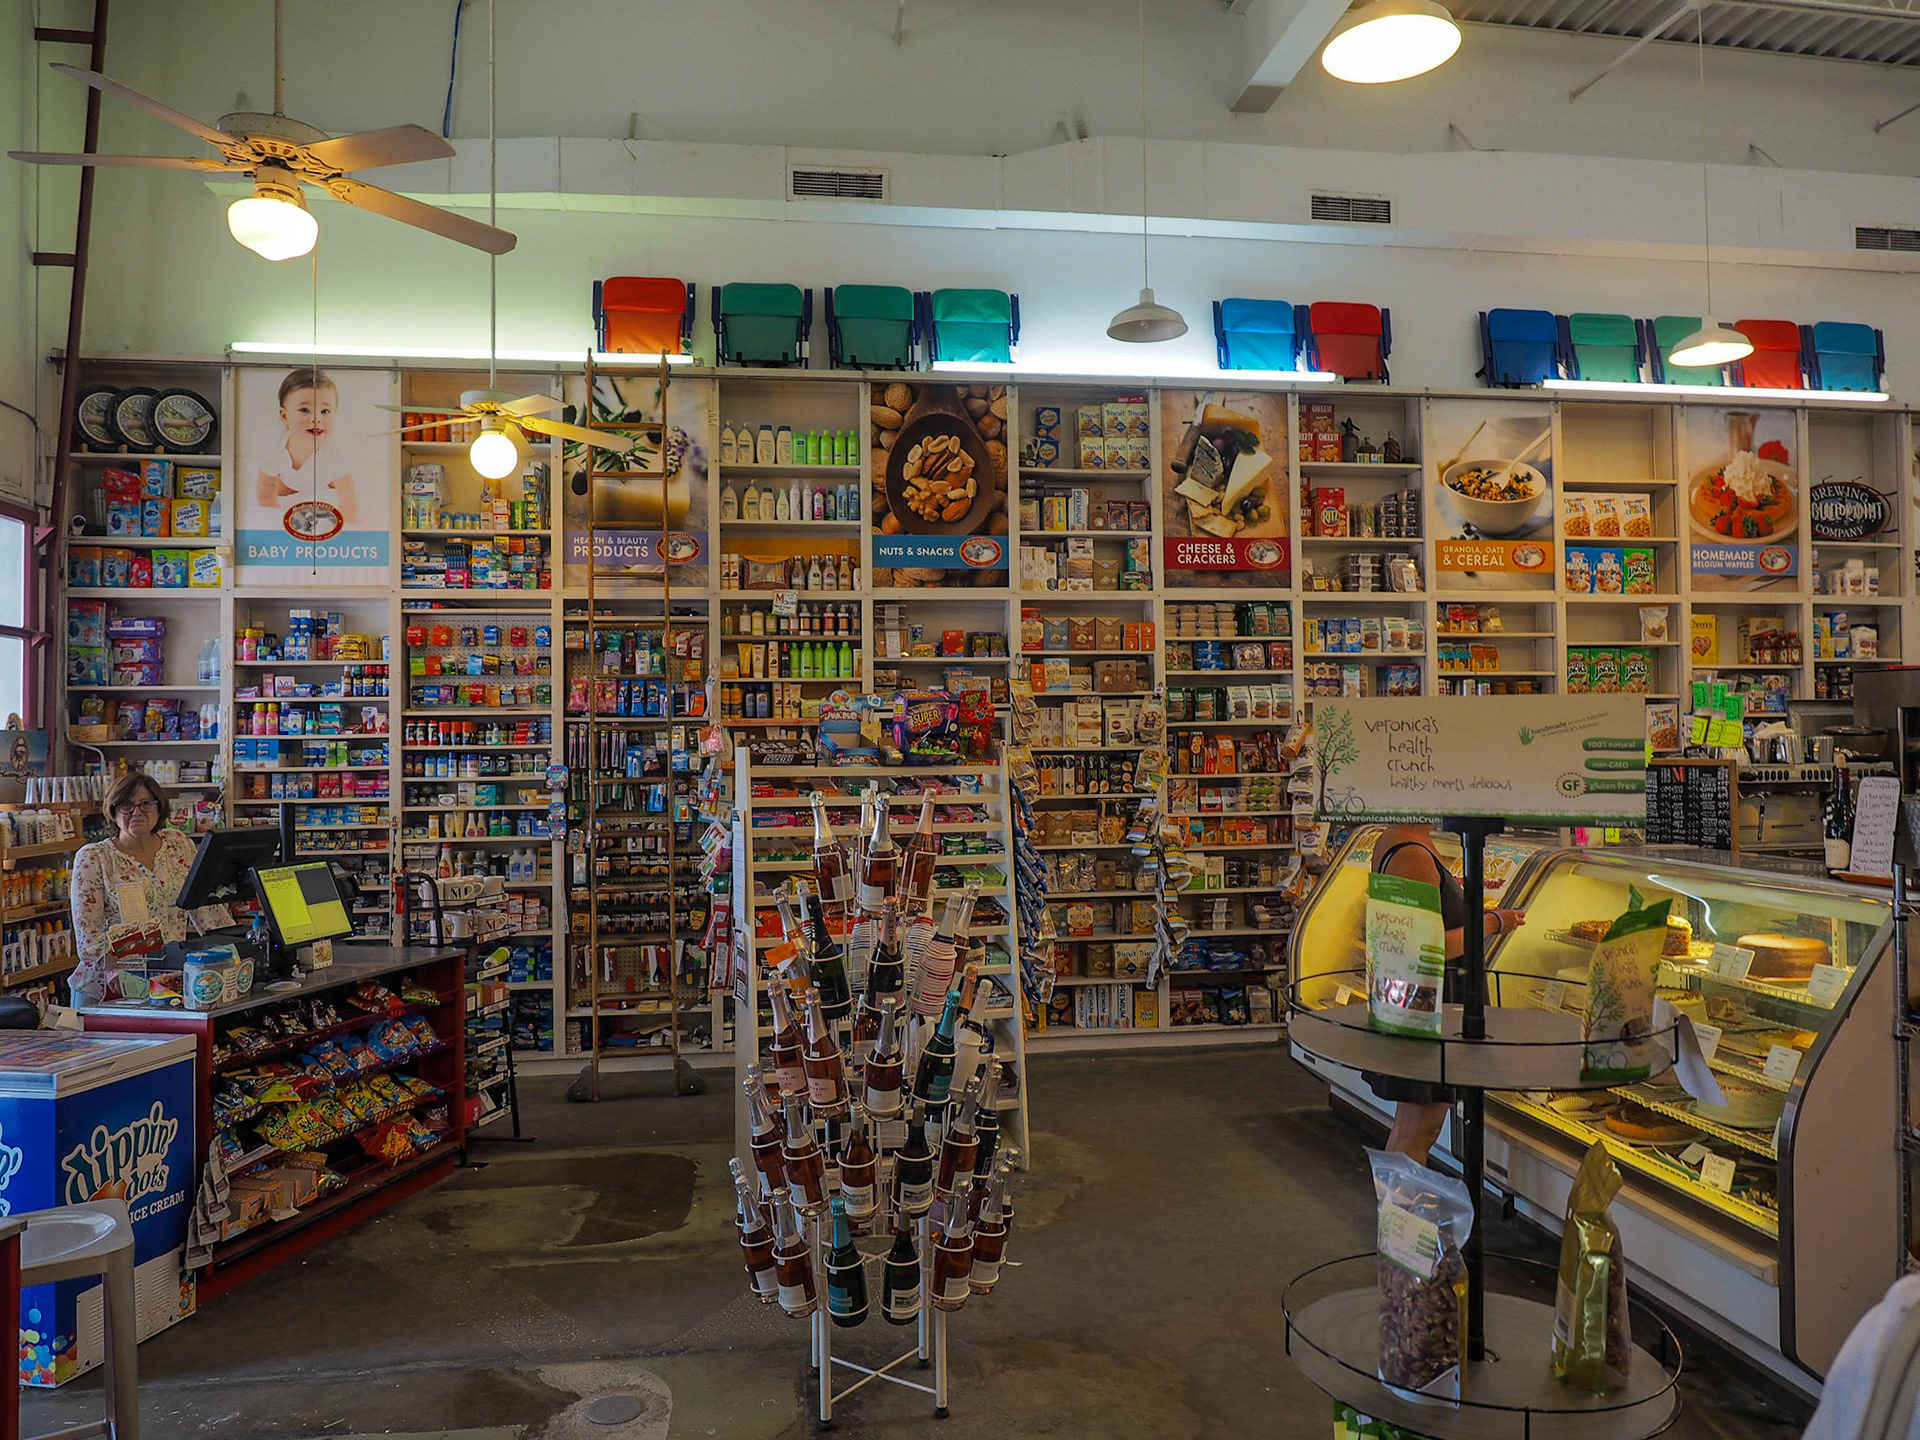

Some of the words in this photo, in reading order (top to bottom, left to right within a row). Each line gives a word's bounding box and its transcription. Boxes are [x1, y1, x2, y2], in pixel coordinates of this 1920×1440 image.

[1105, 409, 1126, 418] Triscuit
[1128, 409, 1148, 418] Triscuit
[1083, 443, 1103, 451] Triscuit
[1811, 485, 1869, 503] BREWING
[1322, 511, 1341, 523] RITZ
[1815, 523, 1863, 538] COMPANY
[574, 536, 605, 545] HEATH
[249, 546, 289, 558] BABY
[295, 546, 378, 558] PRODUCTS
[574, 546, 649, 557] PRODUCTS
[879, 547, 904, 555] NUTS
[907, 547, 914, 555] &
[917, 548, 954, 556] SNACKS
[1177, 543, 1221, 554] CHEESE
[1226, 543, 1235, 554] &
[1443, 546, 1483, 554] GRANOLA,
[1177, 554, 1236, 564] CRACKERS
[1443, 555, 1452, 566] &
[1457, 554, 1505, 566] CEREAL
[1693, 550, 1755, 561] HOMEMADE
[1693, 561, 1724, 569] BELGIUM
[775, 593, 785, 603] M
[912, 709, 939, 724] SUPER
[1364, 714, 1439, 734] veronica's
[1531, 721, 1567, 735] handmade
[1388, 733, 1433, 757] health
[1387, 755, 1435, 772] crunch
[1390, 775, 1428, 791] healthy
[1432, 777, 1464, 791] meets
[1469, 775, 1513, 790] delicious
[1562, 780, 1580, 791] GF
[1589, 782, 1637, 791] gluten-free
[1319, 814, 1443, 824] www.VeronicasHealthCrun
[126, 1165, 169, 1204] dots
[130, 1207, 148, 1225] ICE
[150, 1190, 185, 1219] CREAM
